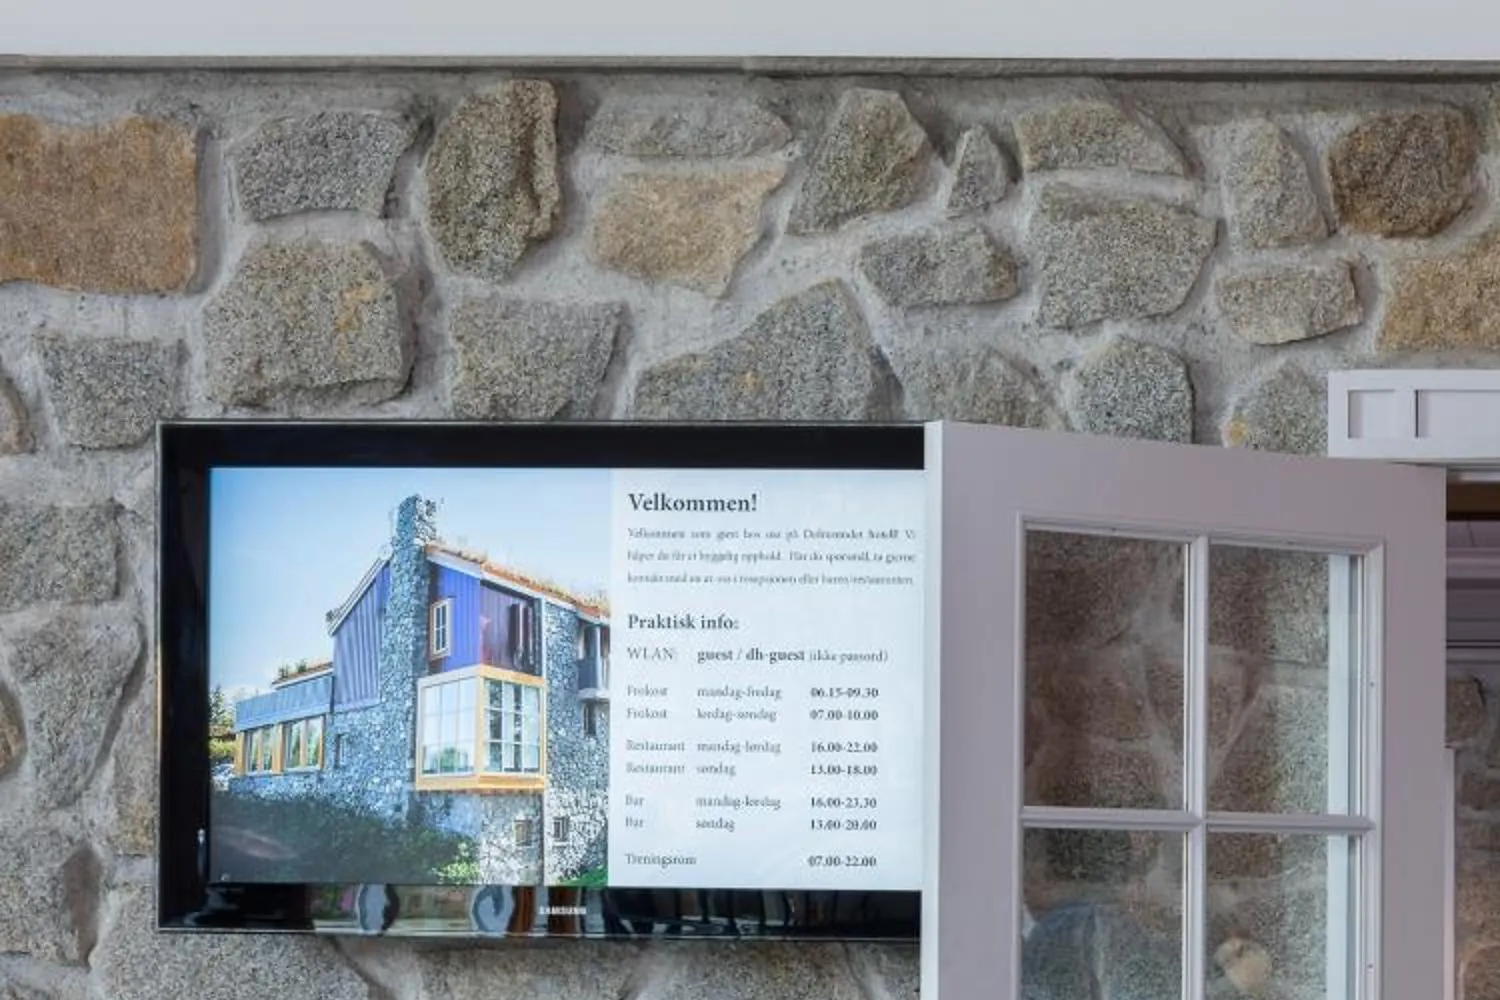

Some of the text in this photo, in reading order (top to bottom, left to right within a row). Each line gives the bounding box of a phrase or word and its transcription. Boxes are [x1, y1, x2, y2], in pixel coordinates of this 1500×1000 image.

[628, 492, 758, 513] Velkommen!
[628, 614, 740, 631] Praktisk info:
[697, 648, 733, 664] guest
[745, 648, 805, 665] dh-guest
[627, 684, 668, 697] Frokost
[697, 684, 782, 701] mandag-fredag
[626, 707, 667, 719] Frokost
[809, 709, 879, 721] 07.00-10.00
[626, 739, 685, 752] Restaurant
[626, 762, 685, 774] Restaurant
[625, 794, 645, 807] Bar
[625, 816, 645, 828] Bar
[696, 816, 736, 832] søndag
[625, 853, 877, 869] Treningsrom 07.00-22.00
